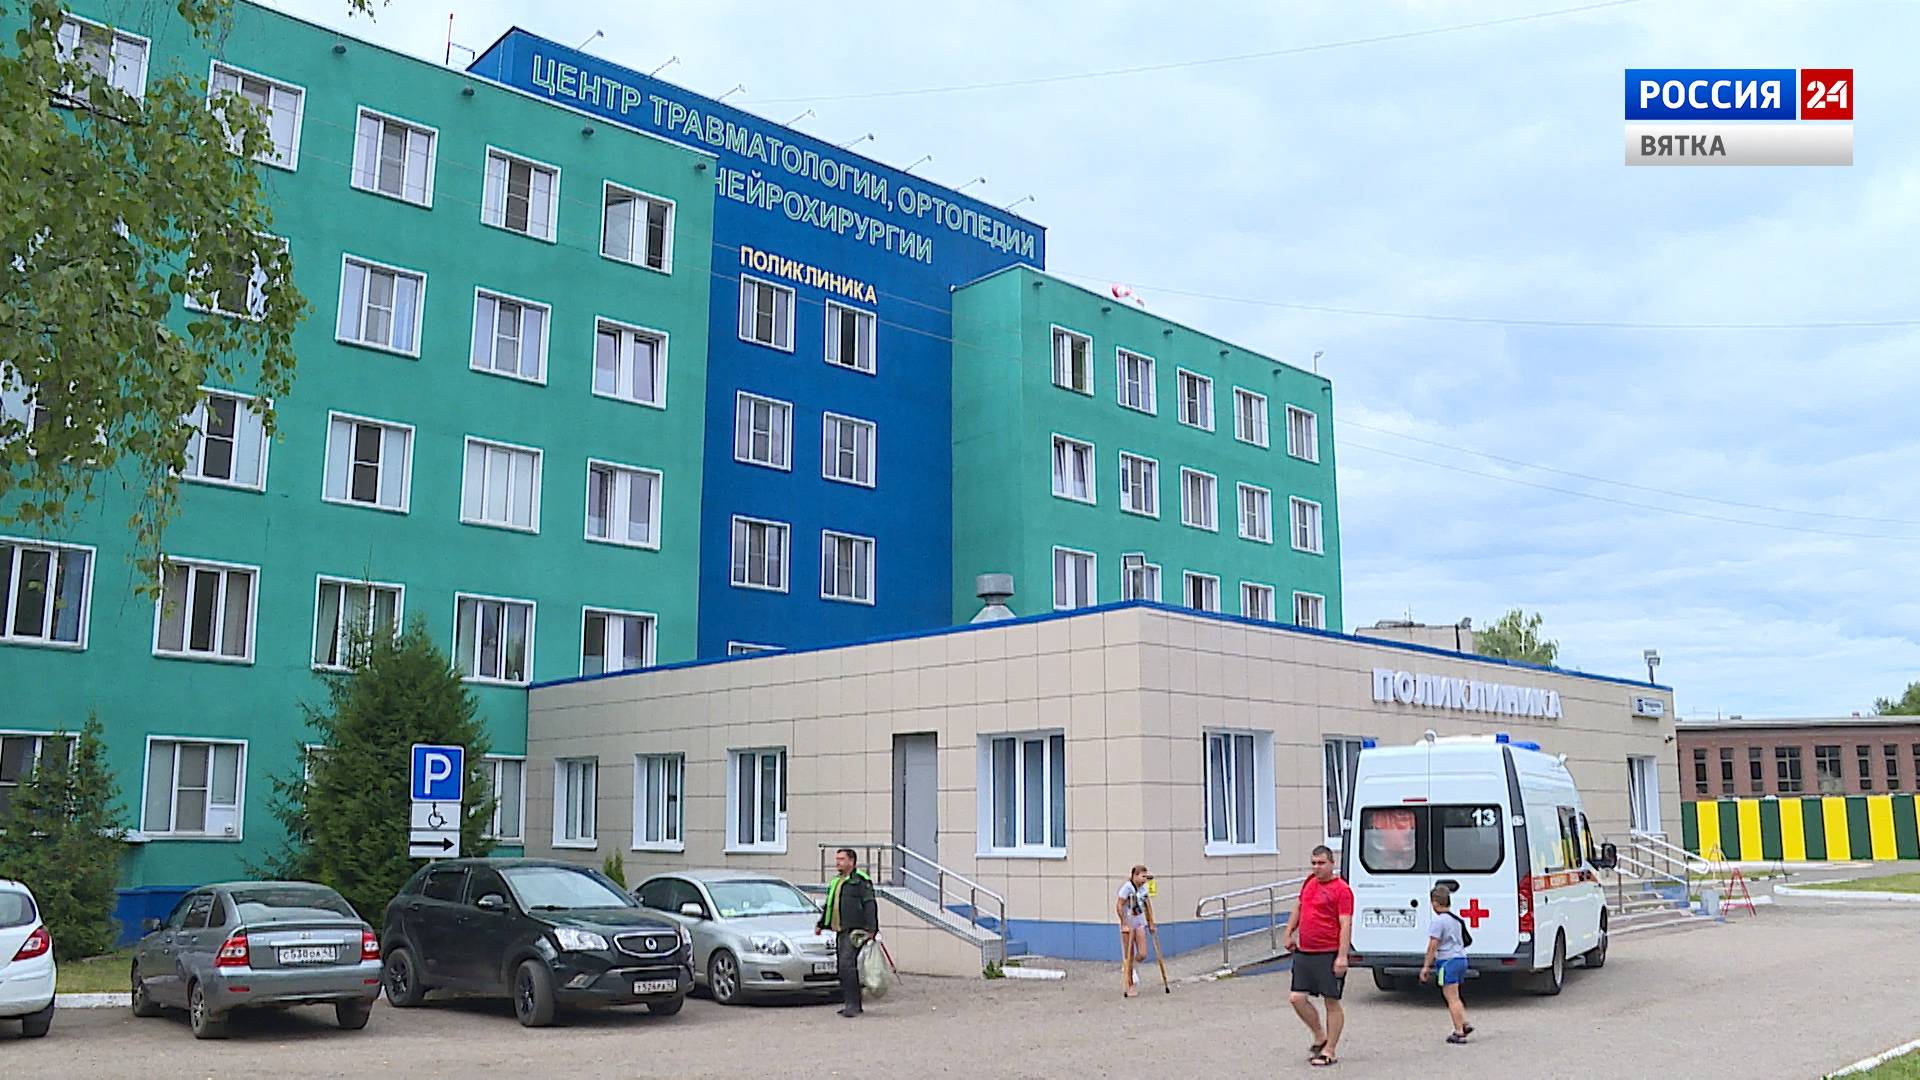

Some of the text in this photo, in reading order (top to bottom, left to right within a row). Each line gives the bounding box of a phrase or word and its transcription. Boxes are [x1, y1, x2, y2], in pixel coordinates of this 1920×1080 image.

[532, 54, 1035, 260] ЦЕНТР ТРАВМАТОЛОГИИ, ОРТОПЕДИИ
[740, 245, 878, 305] ПОЛИКЛИНИКА
[1372, 667, 1564, 720] ПОЛИКЛИНИКА
[424, 753, 452, 794] P
[1472, 808, 1496, 827] 13
